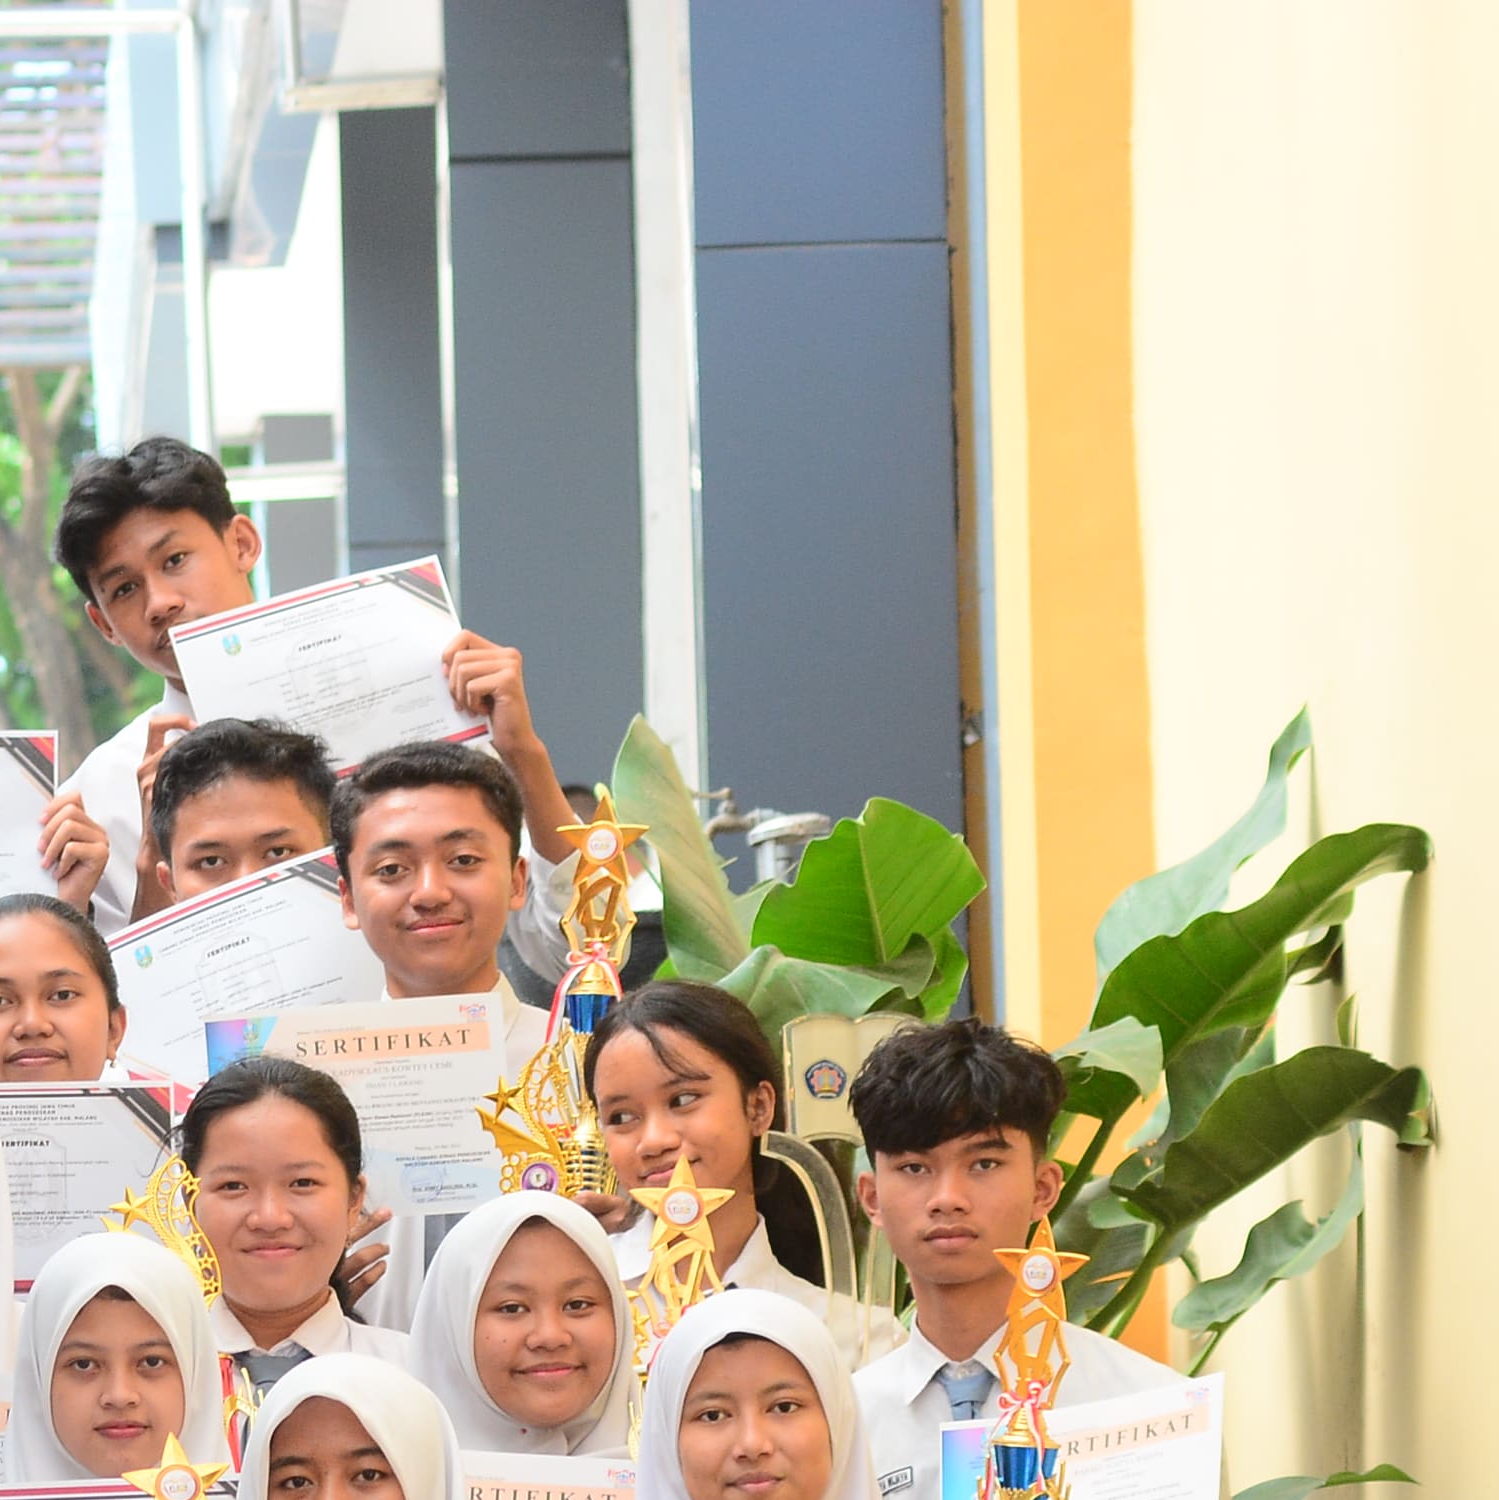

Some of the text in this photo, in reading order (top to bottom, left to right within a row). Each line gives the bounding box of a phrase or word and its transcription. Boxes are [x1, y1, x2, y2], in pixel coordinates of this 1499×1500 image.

[206, 936, 251, 958] SERTIFIKAT
[296, 1028, 472, 1058] SERTIFIKAT
[1067, 1413, 1195, 1457] RTIFIKAT
